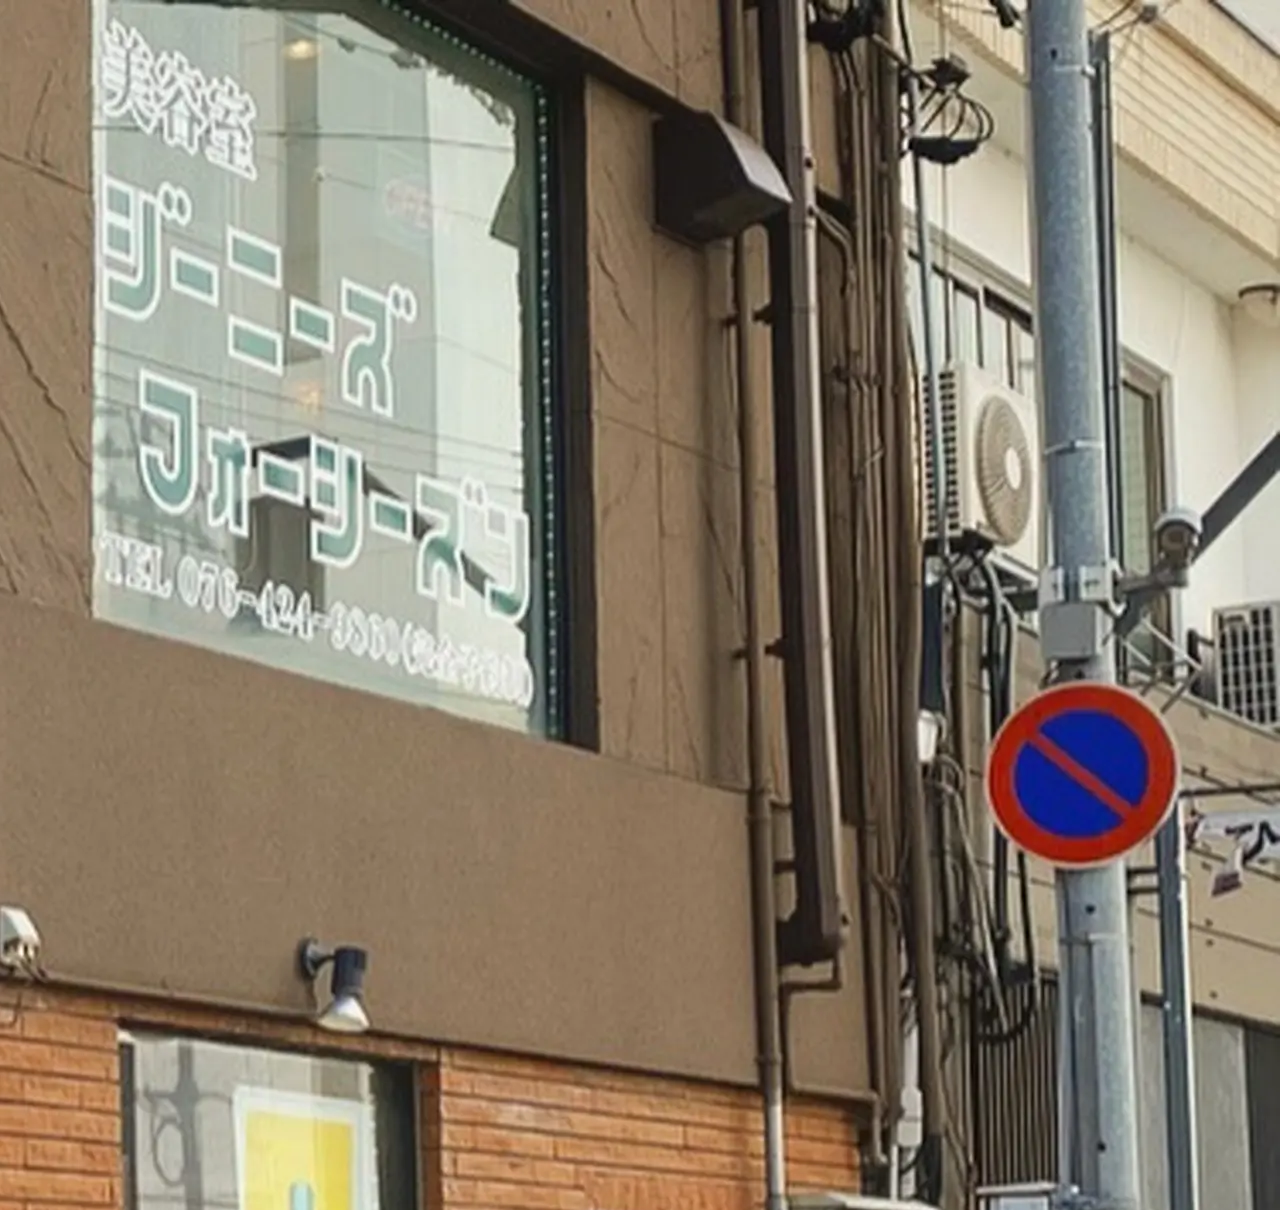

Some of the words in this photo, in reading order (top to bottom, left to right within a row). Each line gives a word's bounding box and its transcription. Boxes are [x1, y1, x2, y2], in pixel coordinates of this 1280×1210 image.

[101, 18, 257, 181] 美容室
[101, 178, 418, 417] ジーニーズ
[100, 533, 173, 599] TEL
[139, 371, 531, 626] フォーシーズン
